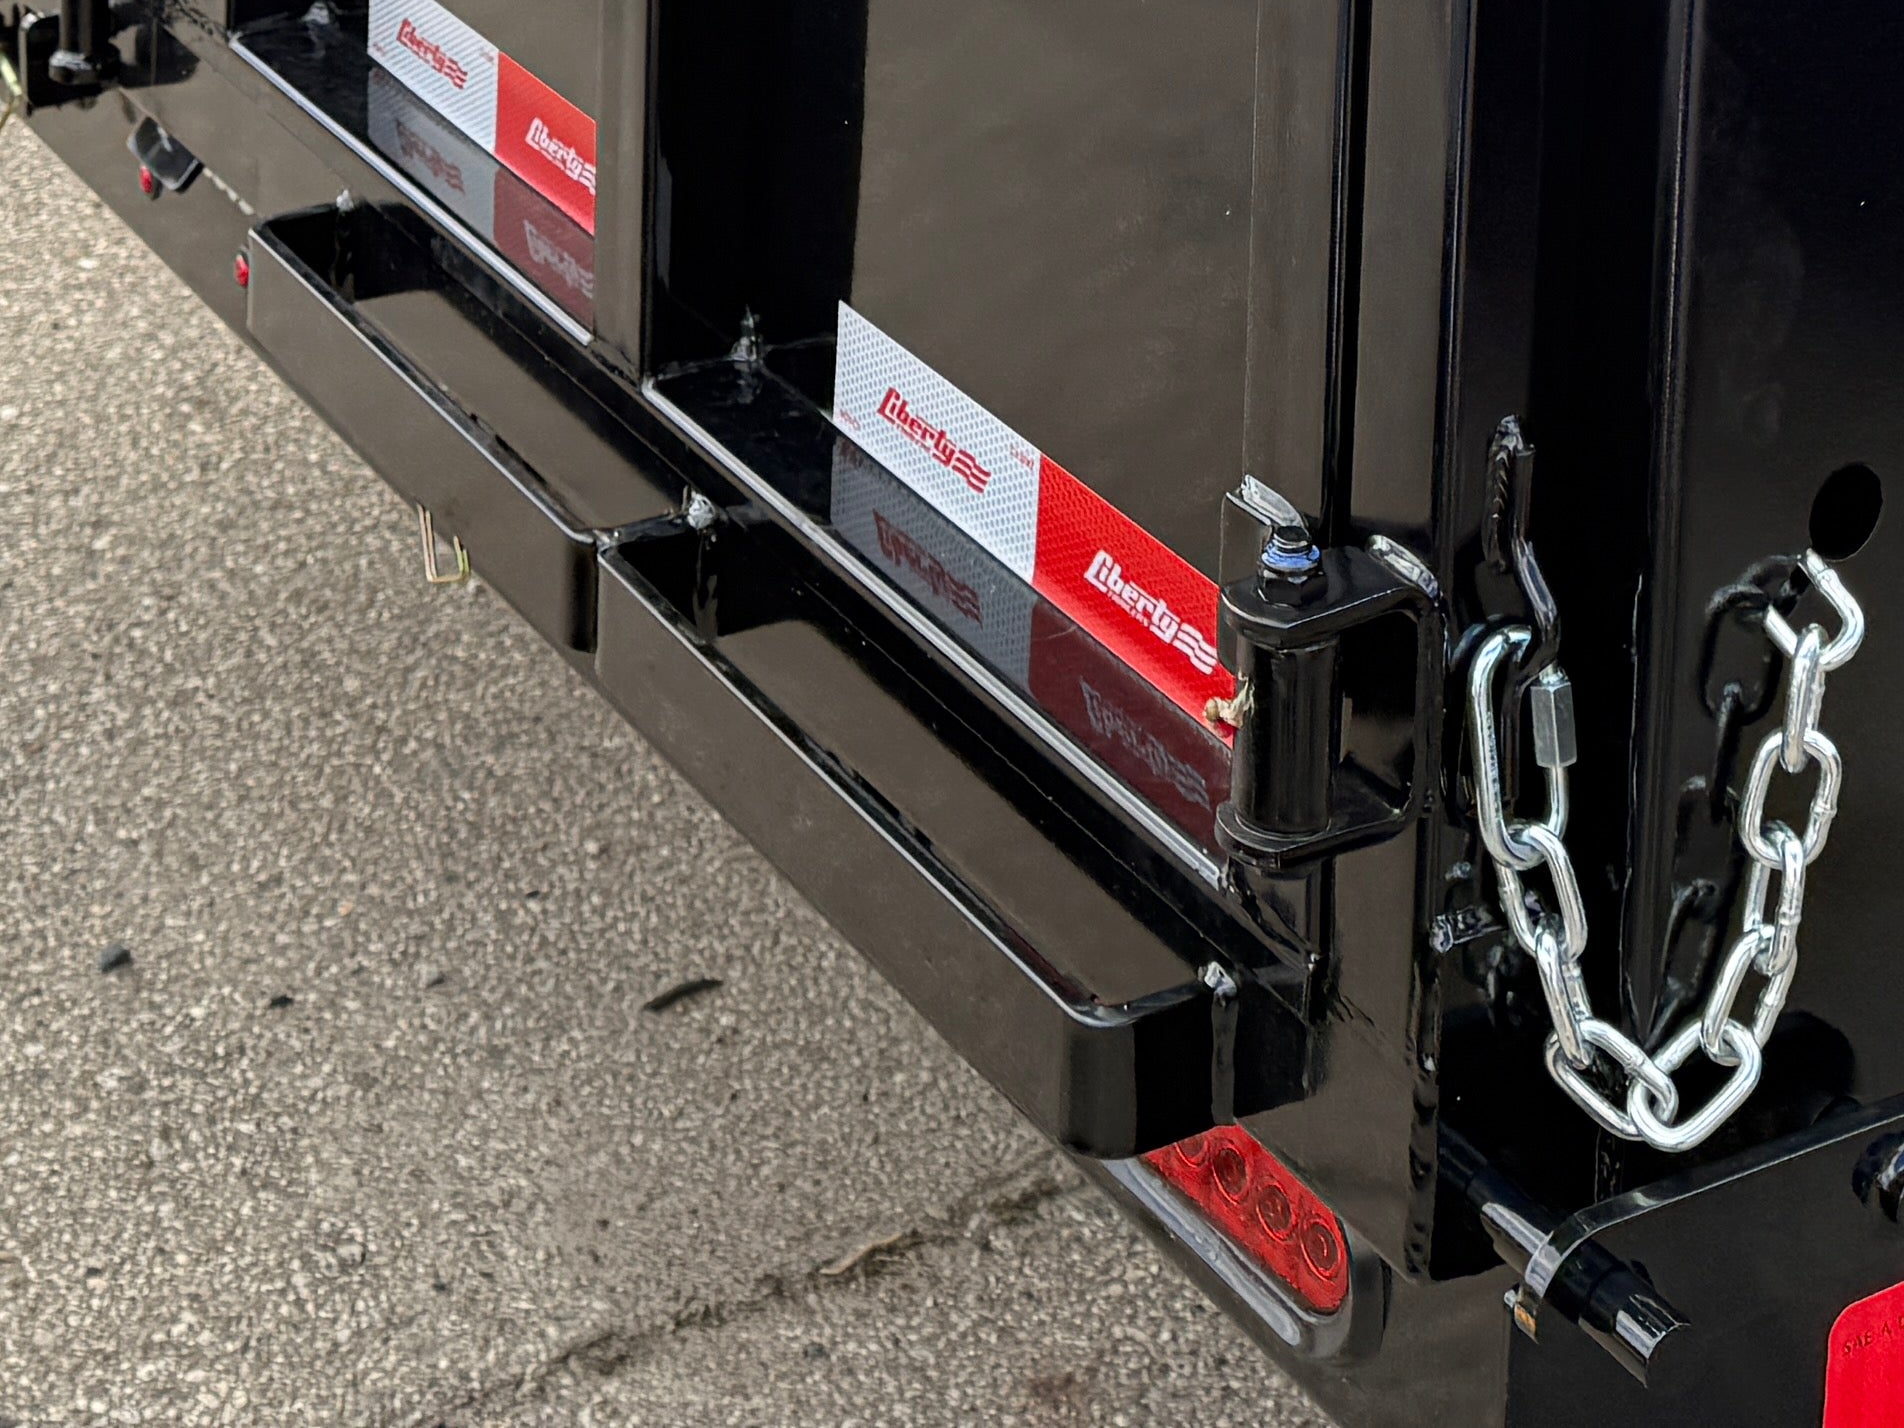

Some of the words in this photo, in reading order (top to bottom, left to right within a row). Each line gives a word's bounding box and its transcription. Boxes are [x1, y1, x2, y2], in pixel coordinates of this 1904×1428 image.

[396, 17, 446, 75] Liberty
[524, 116, 585, 182] Liberty
[876, 386, 958, 468] Liberty
[1082, 548, 1181, 645] Liberty
